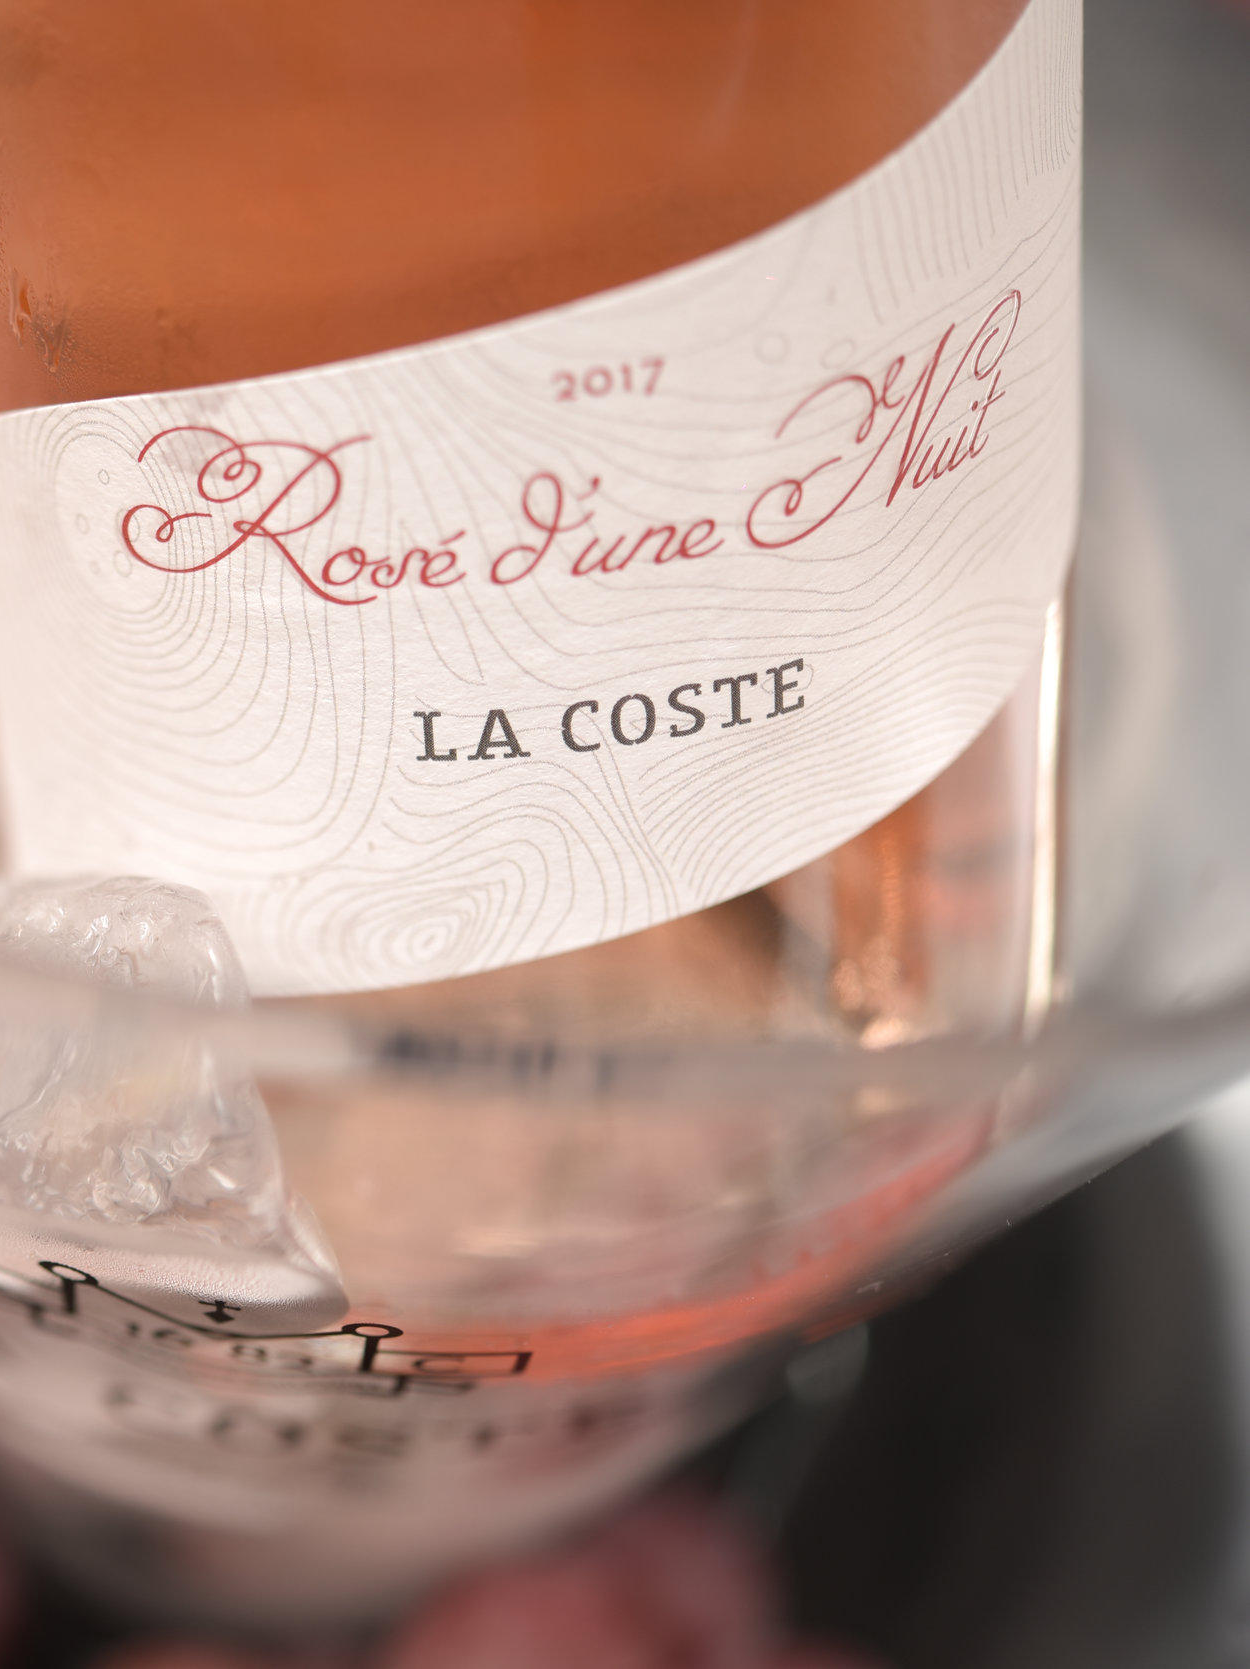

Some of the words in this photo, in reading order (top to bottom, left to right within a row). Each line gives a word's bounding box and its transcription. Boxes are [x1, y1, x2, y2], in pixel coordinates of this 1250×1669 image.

[551, 357, 666, 402] 2017
[122, 424, 466, 605] Rosé
[490, 472, 724, 585] d'une
[414, 710, 531, 762] LA
[561, 658, 806, 753] COSTE
